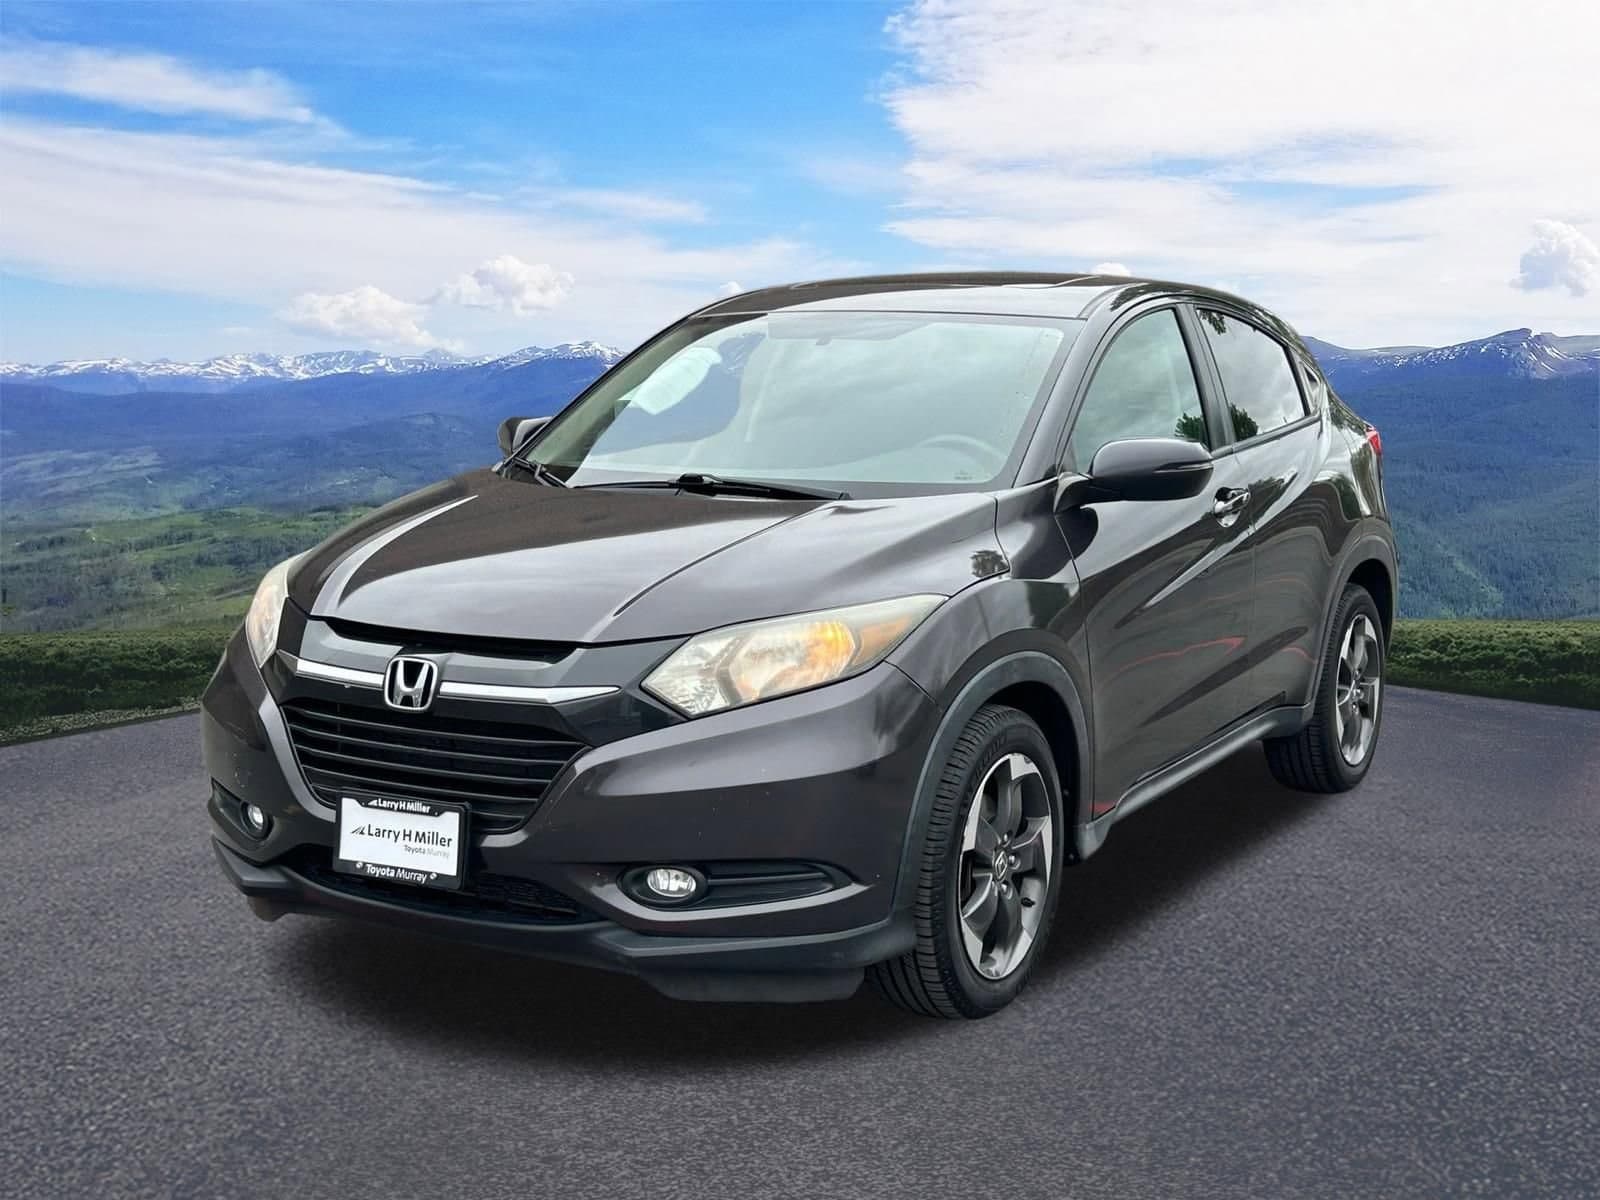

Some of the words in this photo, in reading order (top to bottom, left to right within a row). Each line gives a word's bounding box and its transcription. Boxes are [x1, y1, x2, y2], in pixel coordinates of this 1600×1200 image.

[378, 798, 400, 811] Larry
[400, 800, 406, 811] H
[406, 801, 431, 814] Miller
[368, 823, 400, 843] Larry
[402, 829, 412, 841] H
[414, 830, 453, 848] Miller
[404, 844, 426, 855] Toyota
[426, 846, 450, 859] Murray
[366, 864, 396, 877] Toyota
[396, 869, 427, 884] Murray
